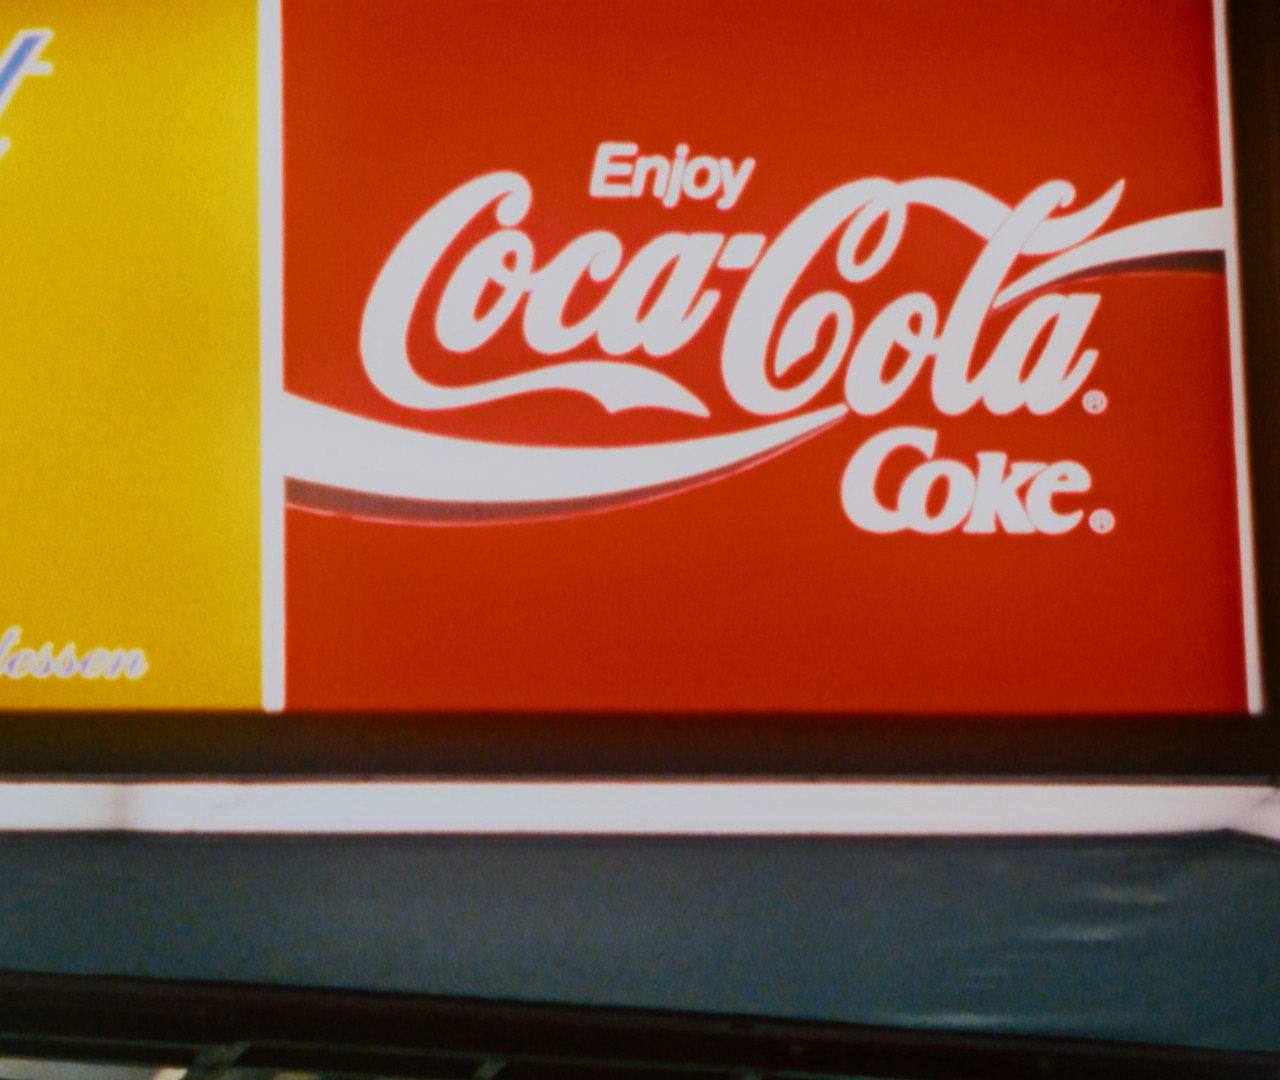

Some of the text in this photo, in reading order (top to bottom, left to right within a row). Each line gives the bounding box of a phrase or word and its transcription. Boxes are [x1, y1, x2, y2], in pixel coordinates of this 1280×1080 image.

[588, 141, 756, 210] Enjoy
[359, 170, 1124, 418] Coca-Cola
[840, 427, 1092, 535] Coke
